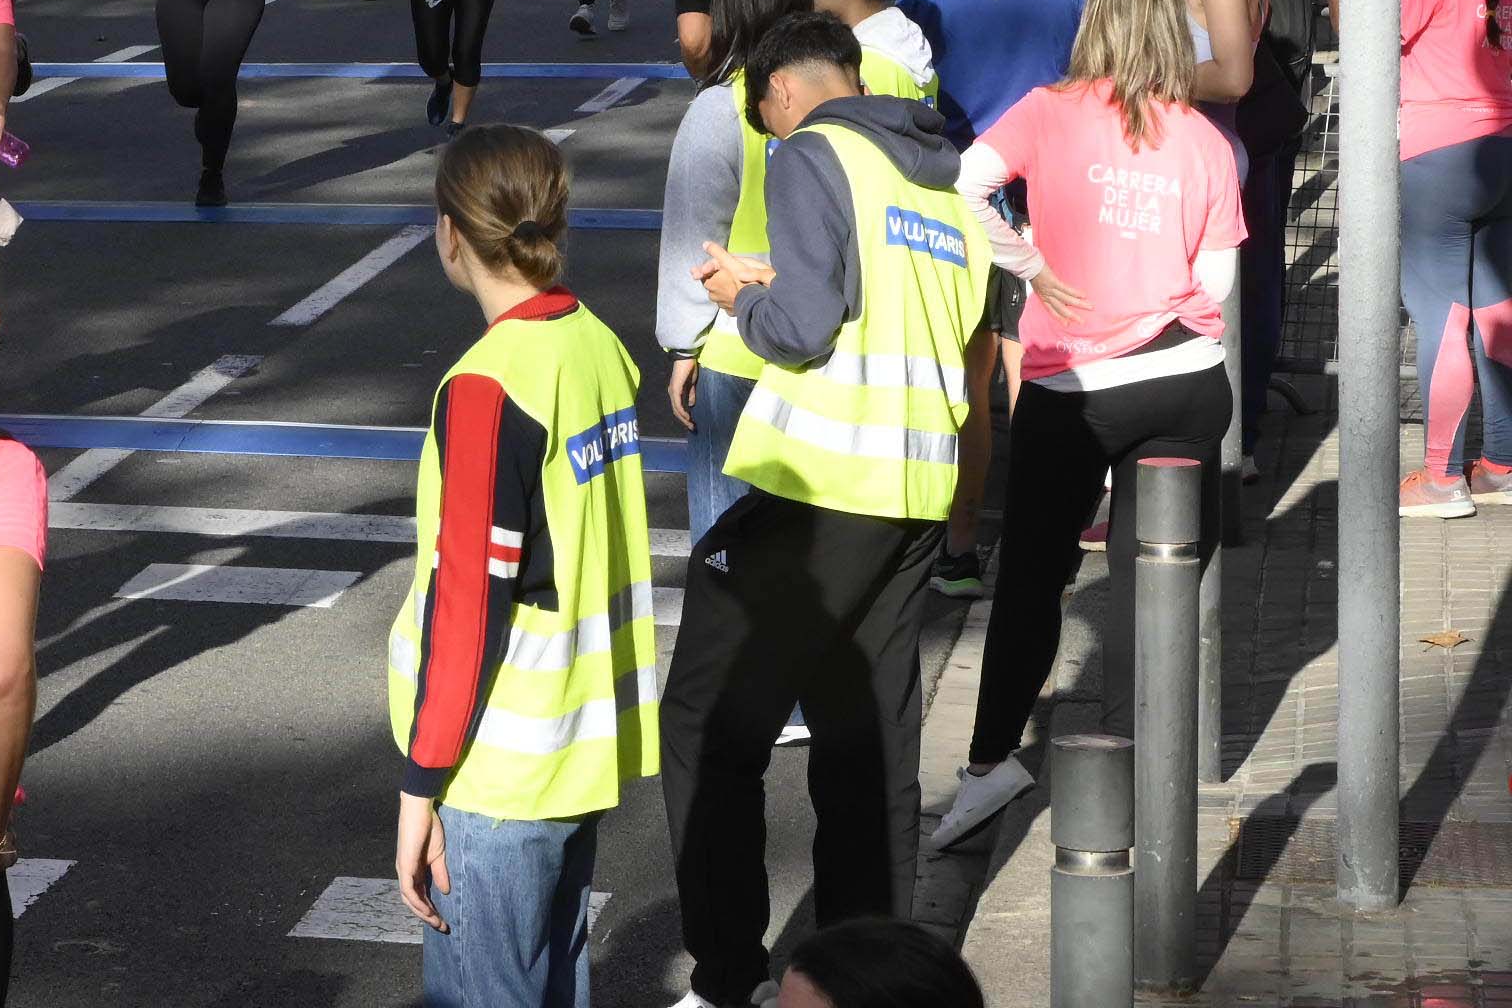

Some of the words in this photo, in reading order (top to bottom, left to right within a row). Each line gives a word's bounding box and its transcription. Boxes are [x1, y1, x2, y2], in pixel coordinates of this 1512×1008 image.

[1088, 164, 1182, 198] CARRERA
[1104, 186, 1129, 207] DE
[1135, 192, 1160, 211] LA
[1098, 206, 1161, 234] MUJER
[704, 557, 729, 572] adidas
